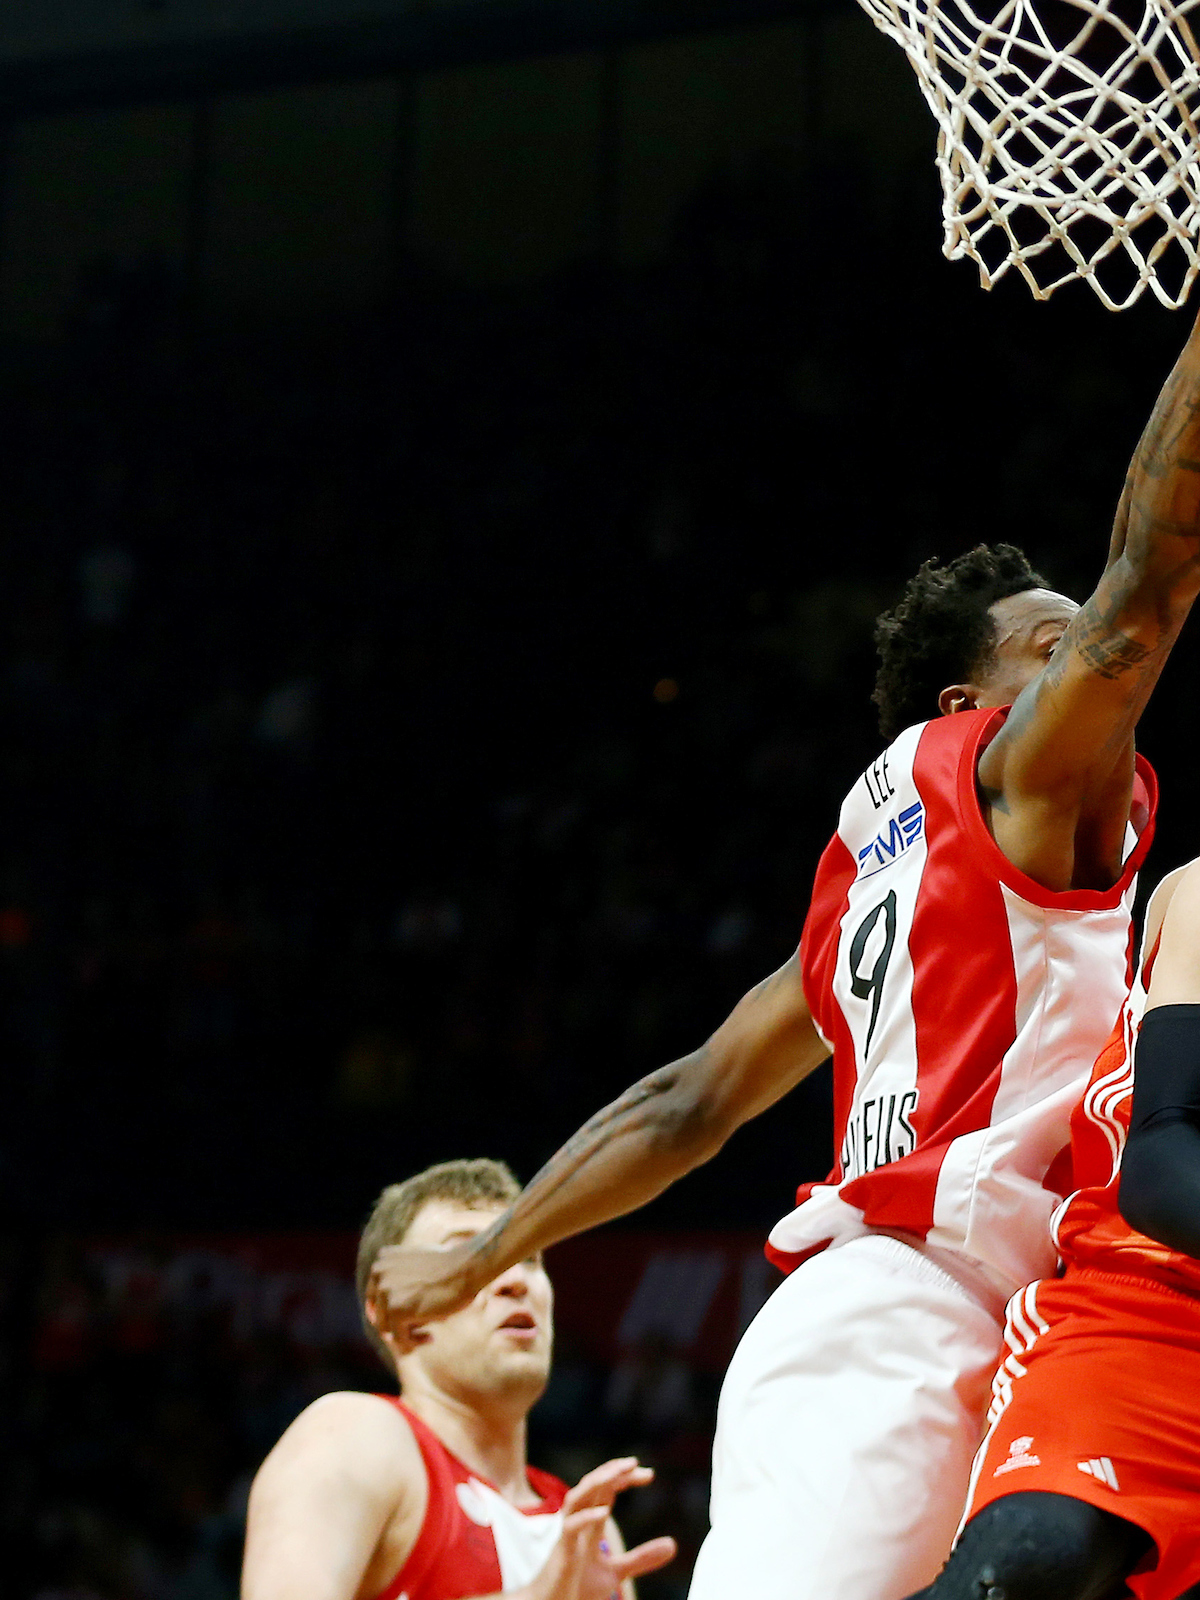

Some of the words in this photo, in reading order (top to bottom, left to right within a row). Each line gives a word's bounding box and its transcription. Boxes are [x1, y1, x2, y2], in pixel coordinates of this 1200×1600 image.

[864, 750, 895, 810] LEE
[857, 800, 923, 872] FMS
[849, 888, 897, 1062] 9
